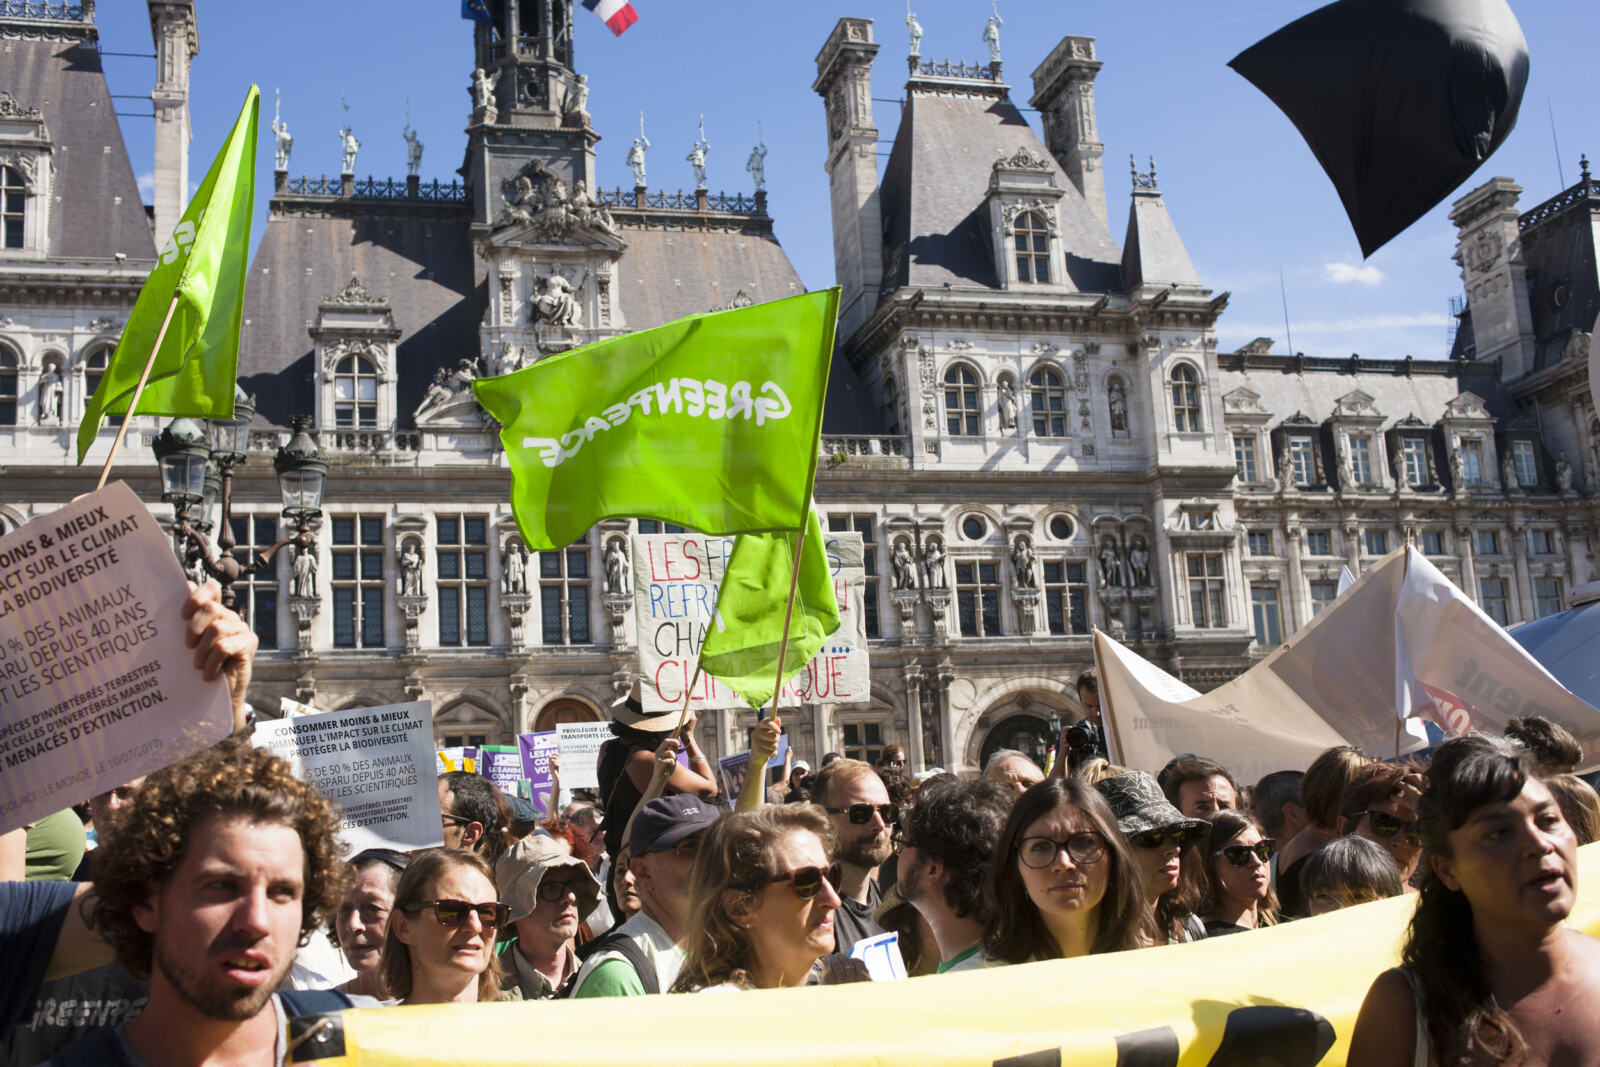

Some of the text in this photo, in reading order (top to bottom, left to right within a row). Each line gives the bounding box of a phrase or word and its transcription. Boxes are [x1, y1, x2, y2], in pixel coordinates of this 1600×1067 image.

[25, 554, 59, 580] SUR
[60, 543, 80, 563] LE
[82, 515, 141, 554] CLIMAT
[39, 533, 55, 549] &
[55, 505, 110, 542] MIEUX
[14, 545, 120, 609] BIODIVERSITÉ
[647, 539, 700, 582] LES
[8, 636, 24, 654] %
[24, 620, 56, 647] DES
[59, 584, 136, 632] ANIMAUX
[30, 629, 88, 668] DEPUIS
[91, 620, 111, 641] 40
[114, 601, 147, 626] ANS
[11, 674, 41, 698] LES
[41, 620, 158, 686] SCIENTIFIQUES
[104, 660, 161, 692] TERRESTRES
[5, 690, 169, 769] MENACÉS D'EXTINCTION.
[12, 726, 46, 748] CELLES
[120, 677, 159, 702] MARINS
[274, 710, 410, 737] CONSOMMER MOINS & MIEUX
[268, 720, 423, 750] DIMINUER L'IMPACT SUR LE CLIMAT
[290, 732, 408, 759] PROTÉGER LA BIODIVERSITÉ
[314, 766, 328, 777] DE
[329, 764, 341, 775] 50
[352, 760, 370, 772] DES
[372, 753, 413, 768] ANIMAUX
[352, 769, 384, 783] DEPUIS
[385, 767, 397, 777] 40
[399, 765, 416, 776] ANS
[337, 786, 353, 798] LES
[354, 776, 417, 795] SCIENTIFIQUES
[387, 804, 408, 813] MARINS
